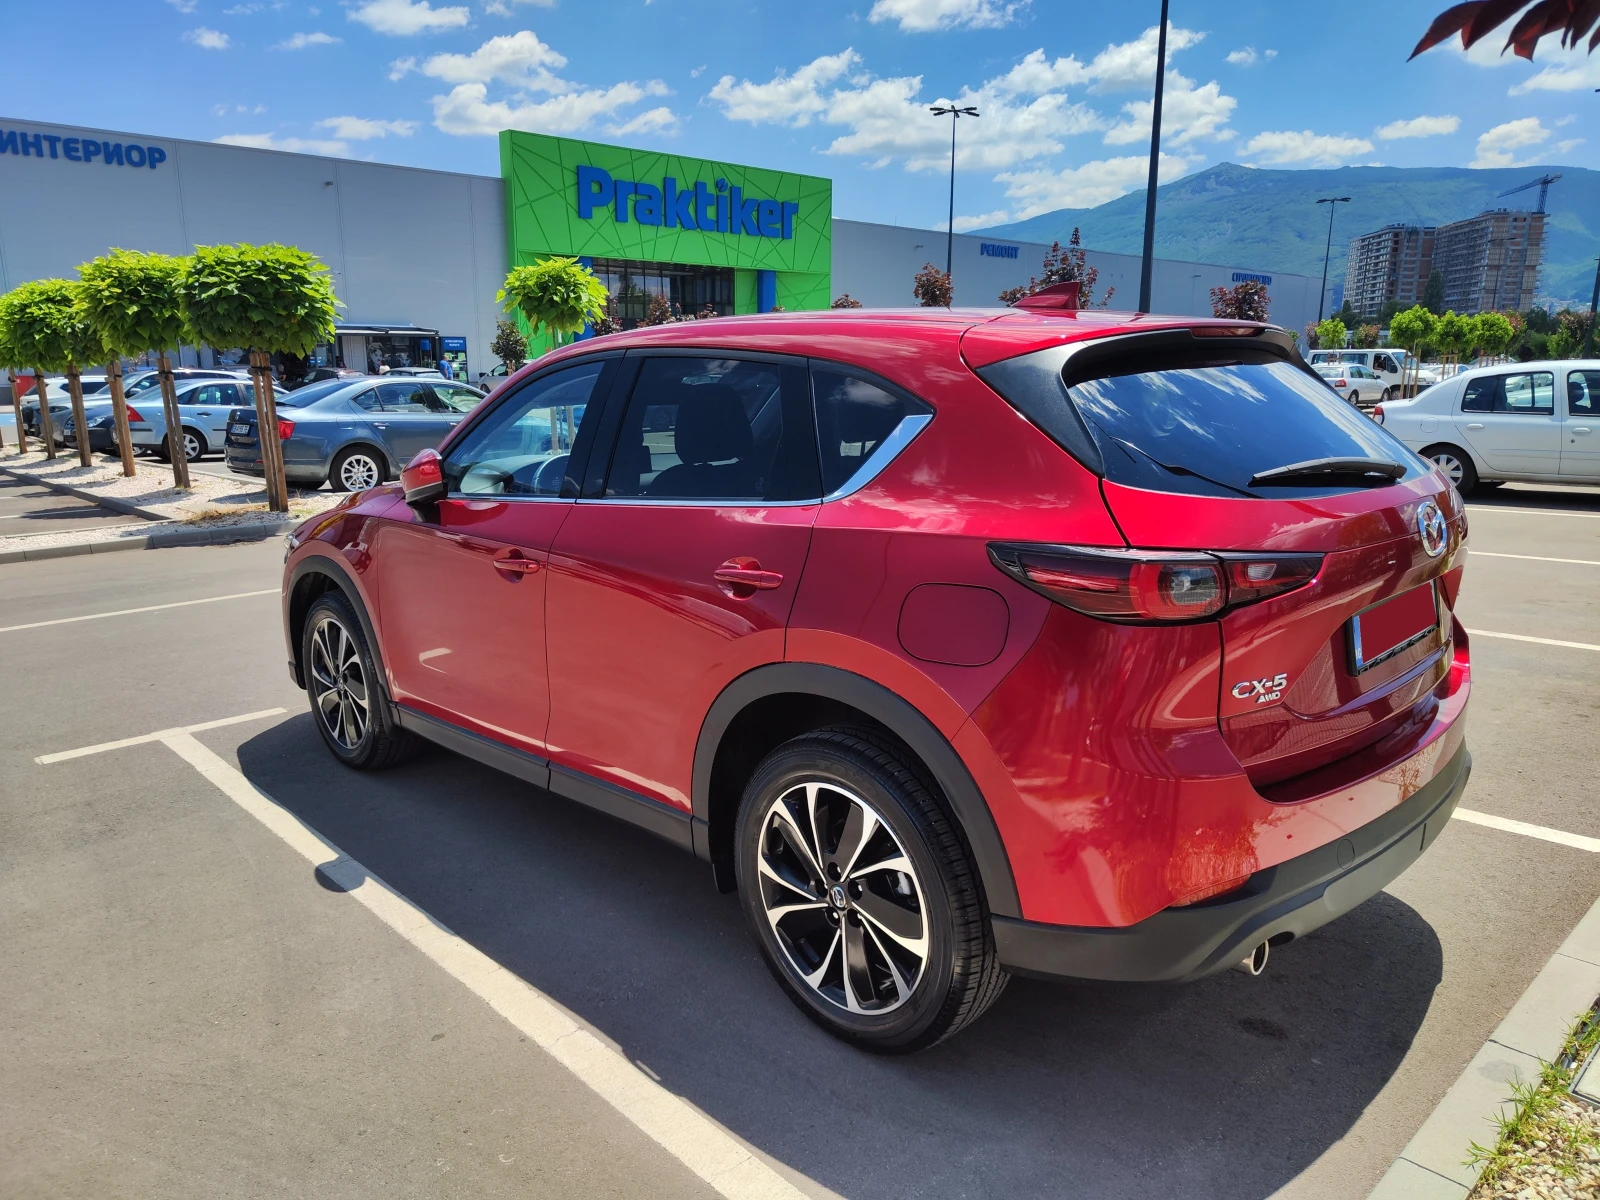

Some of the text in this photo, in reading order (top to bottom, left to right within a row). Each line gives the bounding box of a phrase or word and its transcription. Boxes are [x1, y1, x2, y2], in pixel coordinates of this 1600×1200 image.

[0, 129, 167, 169] ИНТЕРИОР
[576, 164, 799, 240] Praktiker
[980, 242, 1020, 260] РЕМОНТ
[1231, 673, 1288, 699] CX-5
[1255, 690, 1281, 704] AWD
